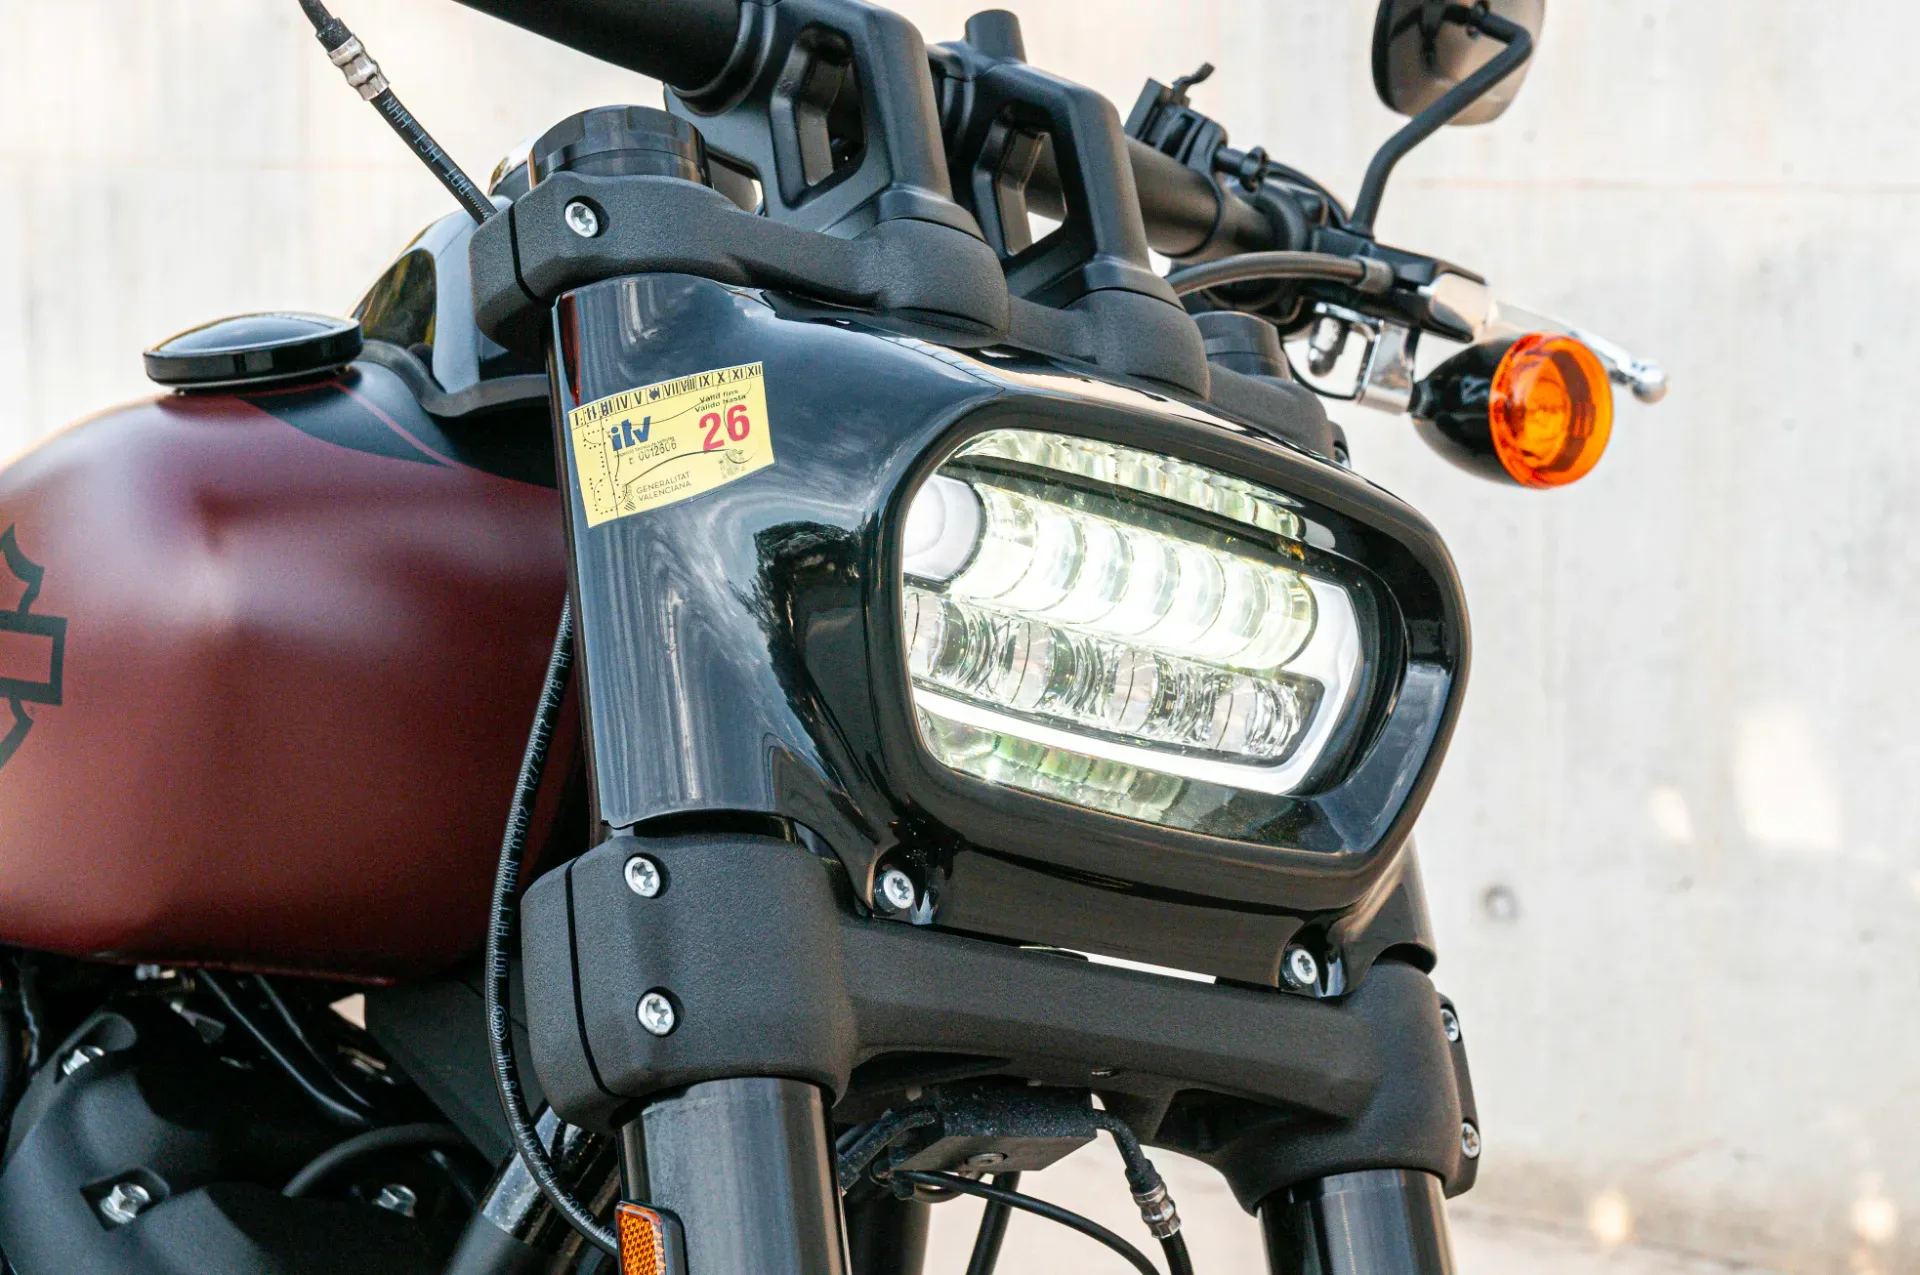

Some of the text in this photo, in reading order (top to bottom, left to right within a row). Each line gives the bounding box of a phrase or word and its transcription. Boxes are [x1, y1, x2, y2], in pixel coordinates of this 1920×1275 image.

[382, 96, 413, 129] HHN
[443, 167, 474, 196] DOT
[616, 394, 628, 411] IV
[634, 391, 642, 405] V
[664, 382, 679, 397] VII
[700, 374, 710, 387] IX
[717, 372, 726, 383] X
[732, 368, 743, 378] XI
[748, 364, 762, 377] XII
[611, 416, 651, 452] itv
[698, 404, 751, 455] 26
[636, 471, 691, 494] GENERALITAT
[638, 480, 692, 502] VALENCIANA
[494, 948, 508, 978] DOT
[510, 809, 532, 850] 0302
[523, 718, 552, 791] 12/2017
